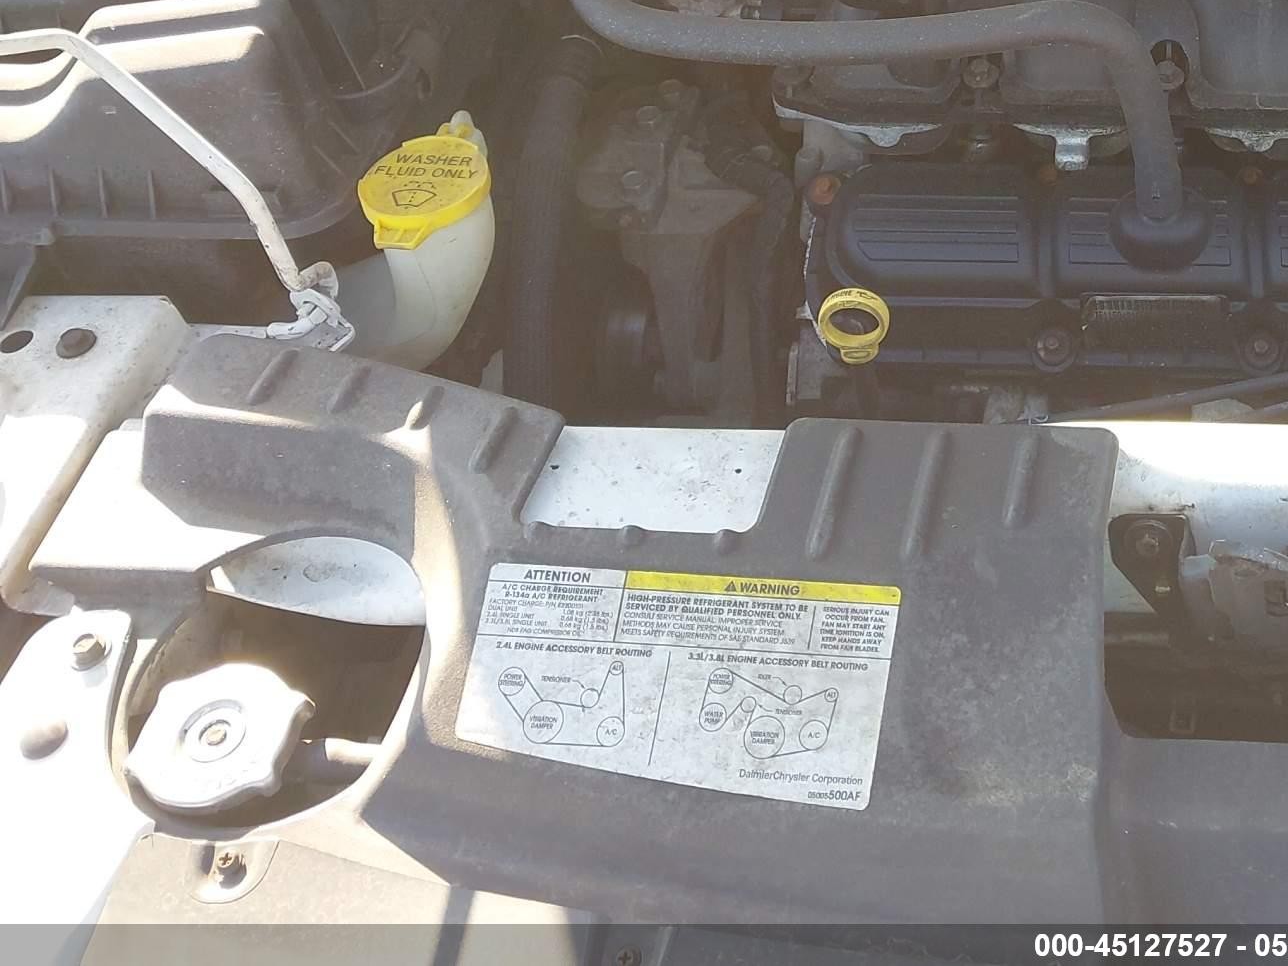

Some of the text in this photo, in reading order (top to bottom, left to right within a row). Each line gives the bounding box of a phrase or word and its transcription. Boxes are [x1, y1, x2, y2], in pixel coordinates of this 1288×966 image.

[396, 154, 472, 166] WASHER
[374, 166, 478, 179] FLUID ONLY
[524, 570, 591, 583] ATTENTION
[552, 586, 603, 596] REQUIREMENT
[740, 582, 800, 596] WARNING
[490, 598, 516, 606] FACTORY
[548, 594, 598, 602] REFRIGERANT
[627, 594, 691, 605] HIGH-PRESSURE
[693, 598, 749, 609] REFRIGERANT
[752, 602, 782, 610] SYSTEM
[625, 603, 666, 612] SERVICED
[682, 606, 724, 615] QUALIFIED
[727, 609, 777, 619] PERSONNEL
[823, 606, 849, 614] SERIOUS
[623, 620, 655, 628] METHODS
[697, 625, 731, 633] PERSONAL
[759, 628, 784, 636] SYSTEM
[718, 618, 753, 626] IMPROPER
[756, 620, 783, 628] SERVICE
[667, 631, 717, 639] REQUIREMENTS
[742, 636, 779, 644] STANDARD
[836, 629, 864, 637] IGNITION
[496, 642, 652, 658] 2.4L ENGINE ACCESSORY BELT ROUTING
[688, 652, 868, 671] 3.3L/3.8L ENGINE ACCESSORY BELT ROUTING
[808, 731, 820, 739] A/C
[739, 769, 863, 785] DaimlerChrysler Corporation
